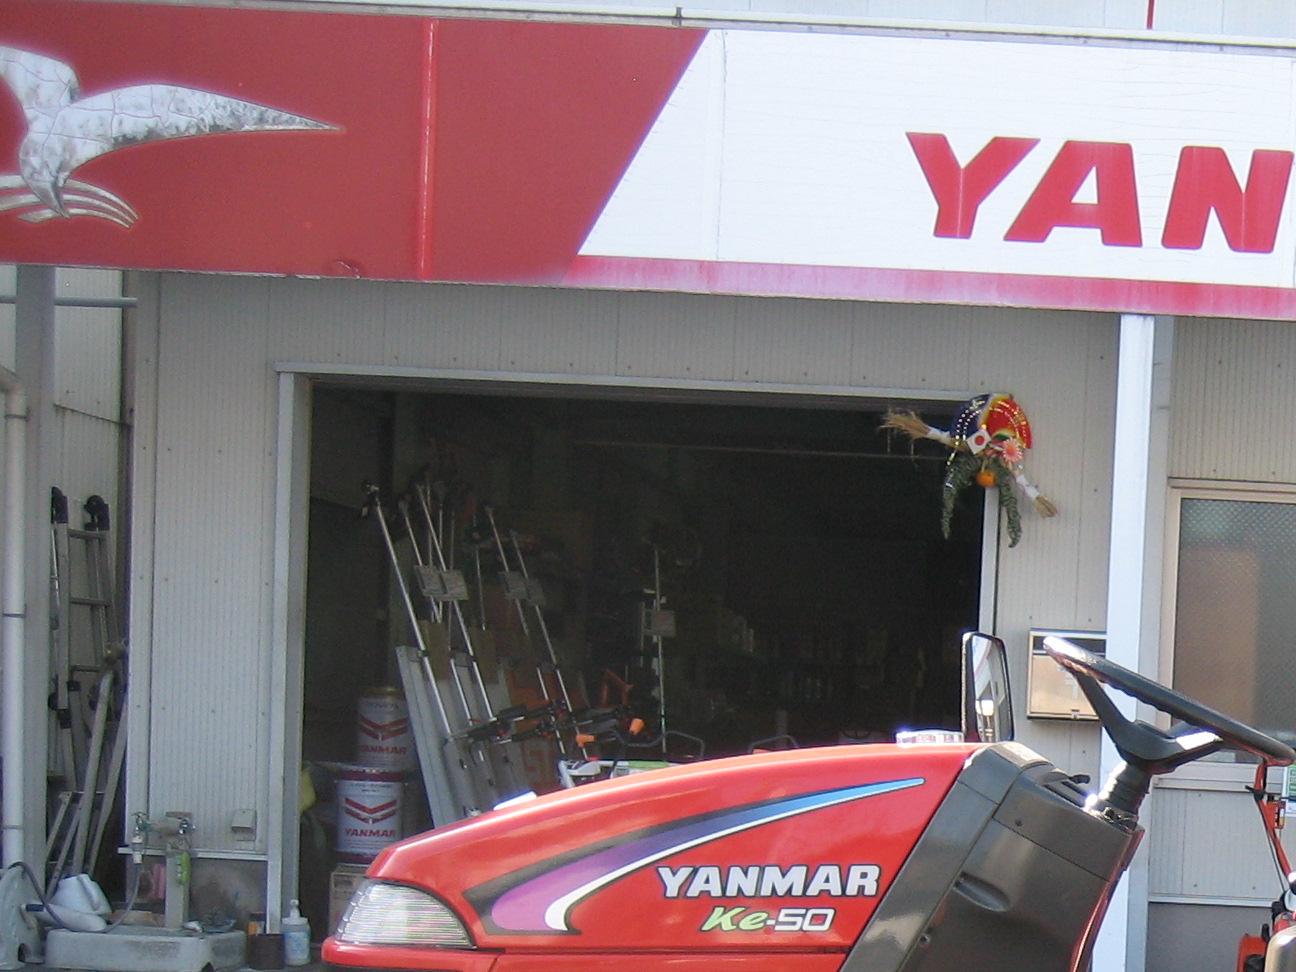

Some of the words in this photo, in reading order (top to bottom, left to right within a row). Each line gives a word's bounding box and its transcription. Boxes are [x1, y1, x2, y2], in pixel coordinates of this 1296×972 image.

[345, 828, 396, 838] YANMAR
[657, 865, 881, 898] YANMAR
[700, 906, 836, 932] Ke-50
